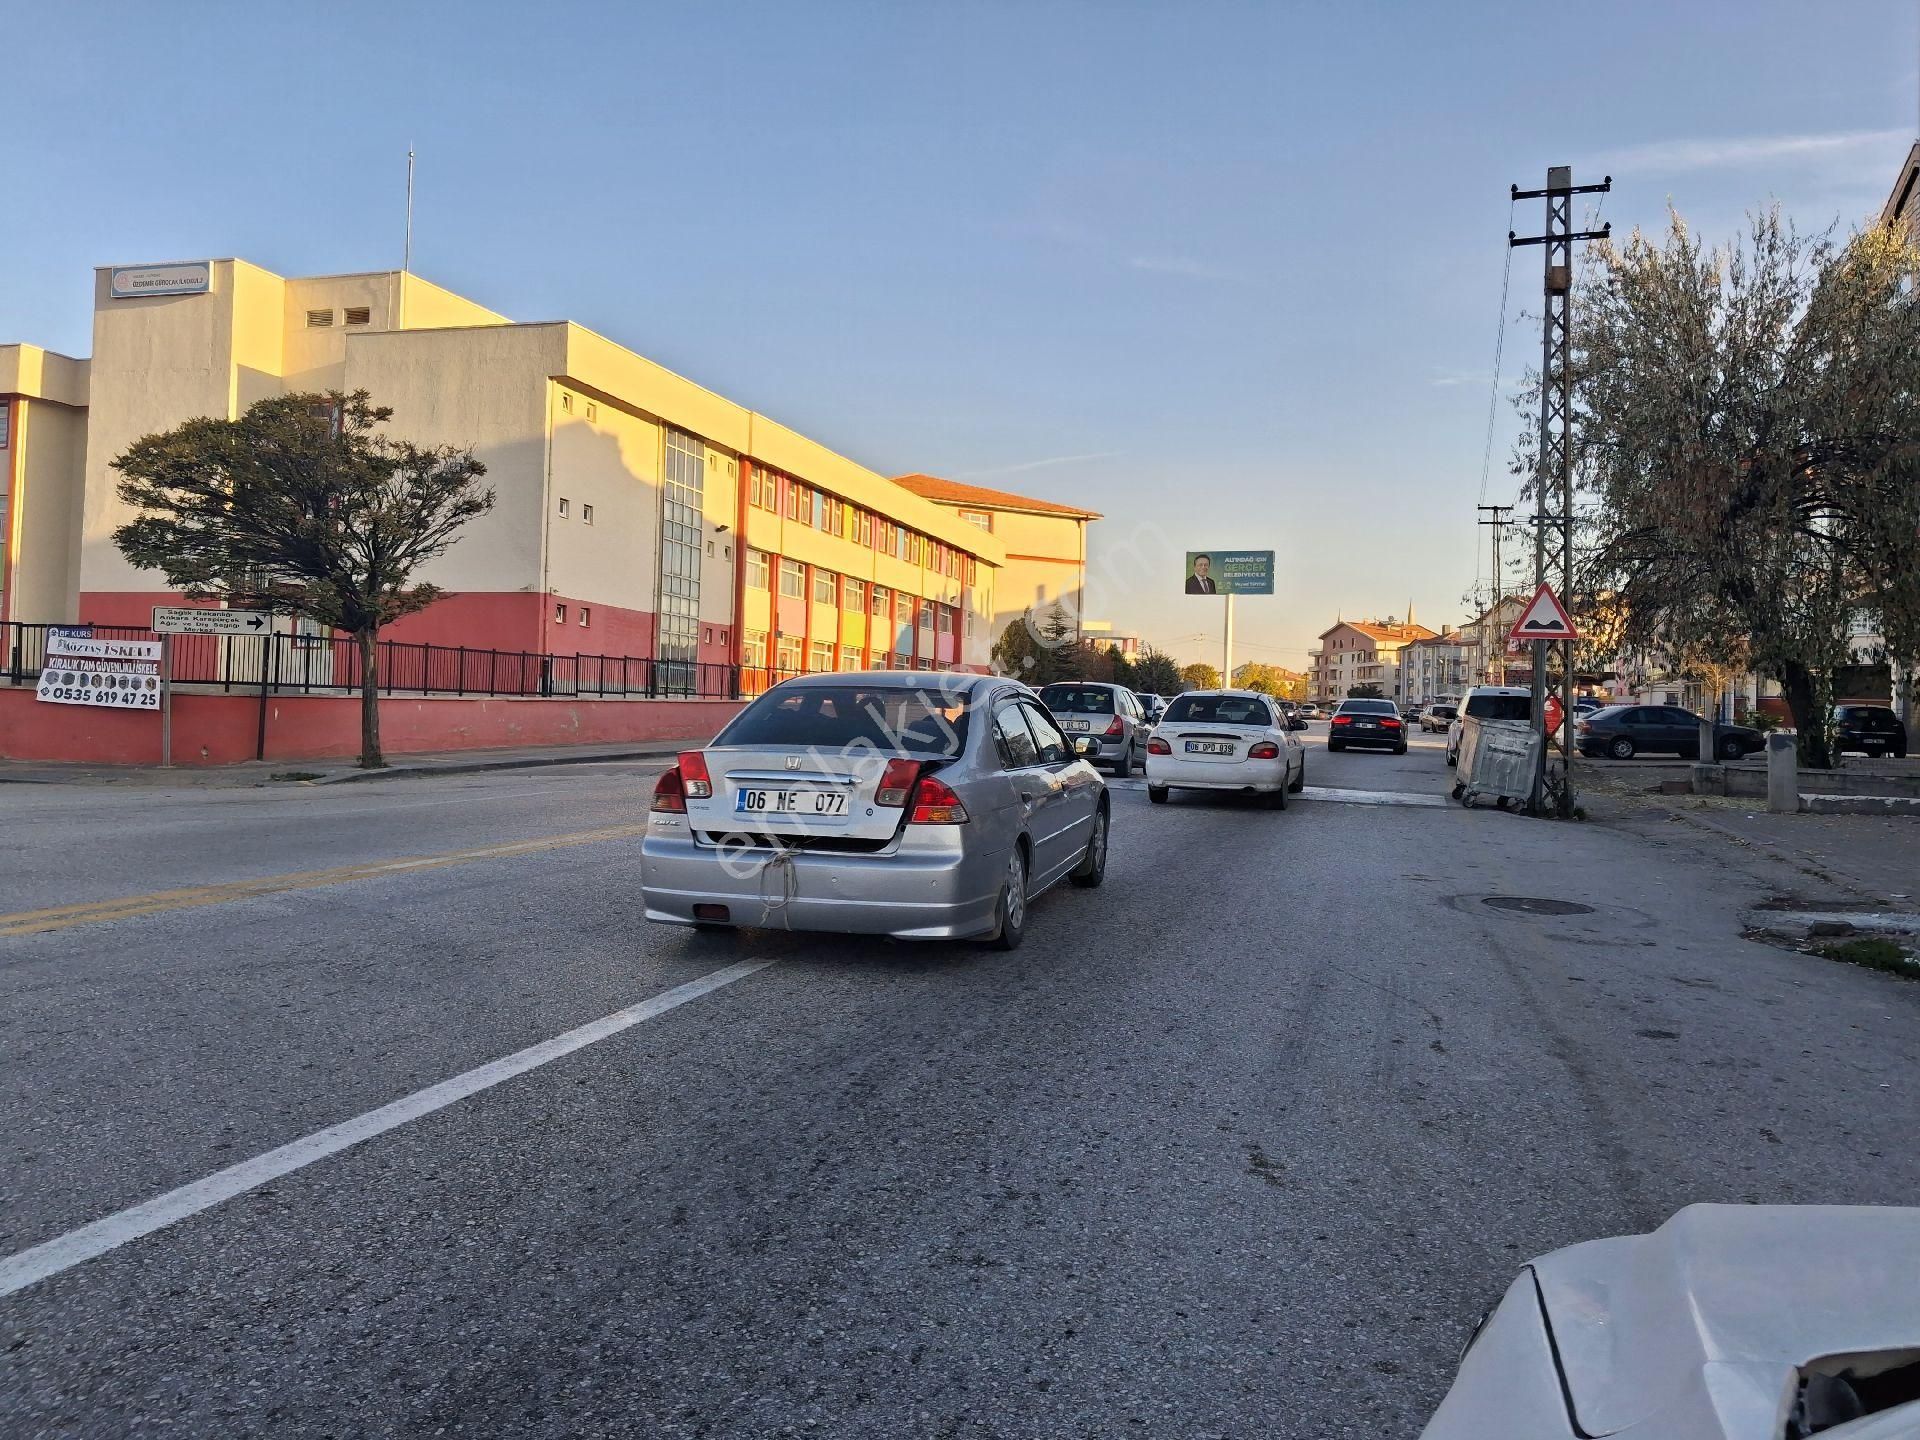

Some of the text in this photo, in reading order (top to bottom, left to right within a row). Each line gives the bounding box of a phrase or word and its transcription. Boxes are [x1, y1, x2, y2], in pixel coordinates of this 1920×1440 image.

[71, 630, 92, 638] KURS
[103, 642, 155, 657] İSKELE
[48, 657, 158, 674] KİRALIK TAM GÜVENLİKLİ İSKELE
[53, 687, 156, 705] 0535 619 47 25
[746, 791, 845, 813] 06 NE 077
